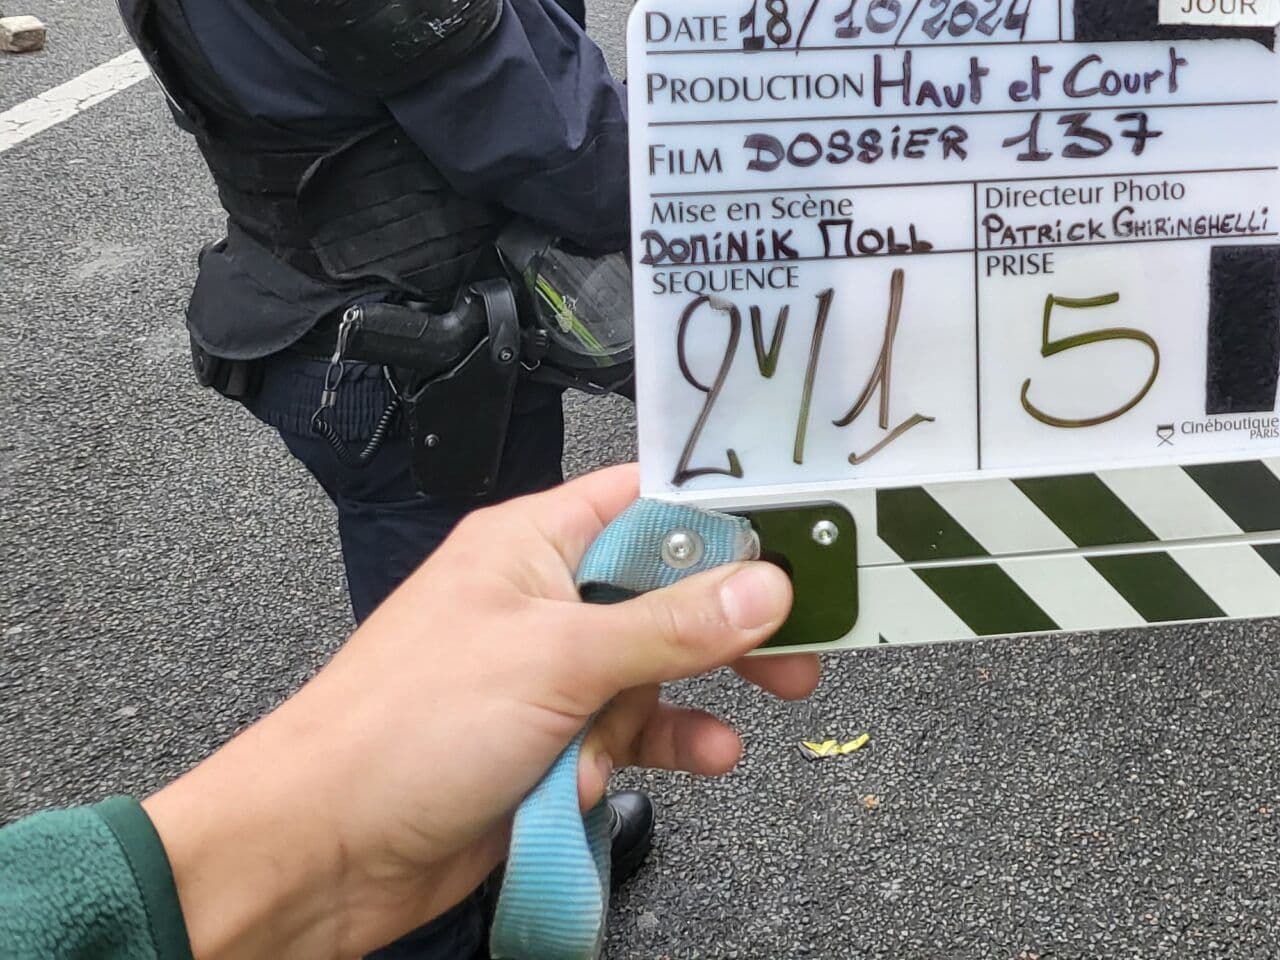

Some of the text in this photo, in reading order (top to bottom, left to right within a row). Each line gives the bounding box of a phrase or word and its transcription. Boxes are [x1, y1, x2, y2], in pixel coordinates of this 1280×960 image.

[645, 11, 728, 43] DATE
[646, 72, 864, 105] PRODUCTION
[1008, 55, 1053, 101] et
[1063, 47, 1188, 98] Court
[1001, 111, 1163, 162] 137
[649, 144, 723, 176] FILM
[650, 193, 854, 225] Mise en Scène
[985, 179, 1186, 209] Directeur Photo
[652, 265, 800, 296] SEQUENCE
[986, 252, 1055, 277] PRISE
[1020, 292, 1161, 429] 5
[1181, 416, 1279, 434] Cinéboutique
[1250, 427, 1280, 440] PARIS
